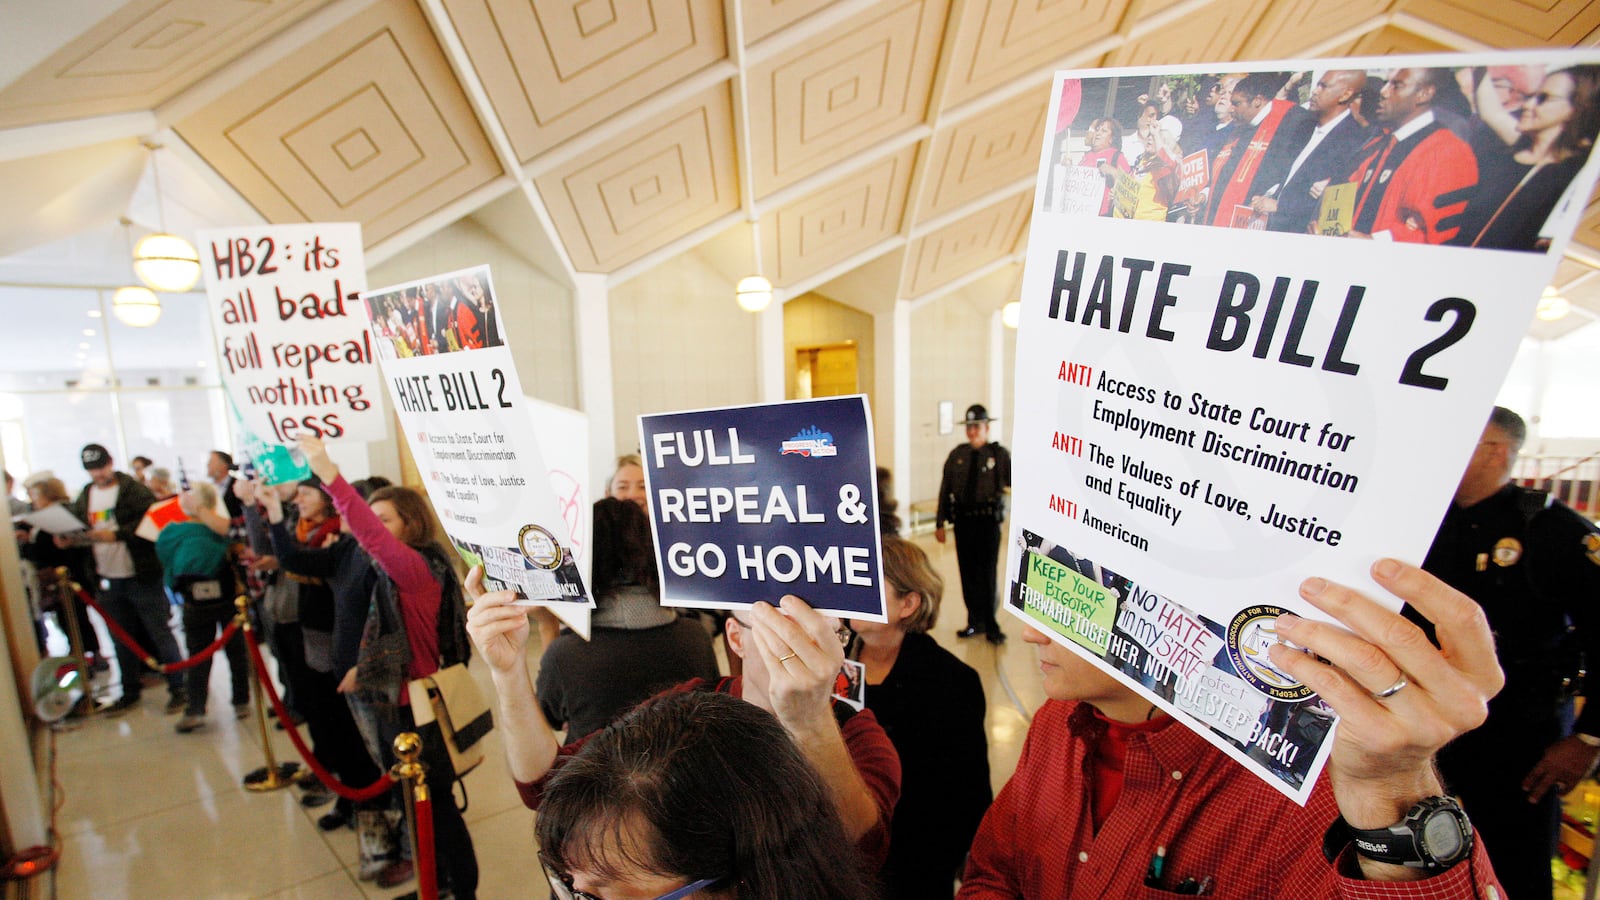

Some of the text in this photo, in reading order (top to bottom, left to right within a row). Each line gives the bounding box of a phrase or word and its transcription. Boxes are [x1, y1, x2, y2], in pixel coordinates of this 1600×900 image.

[304, 236, 340, 272] its
[221, 287, 258, 325] all
[1048, 249, 1477, 392] HATE BILL 2
[223, 329, 373, 380] full repeal
[247, 375, 372, 412] nothing
[394, 367, 513, 413] HATE BILL 2
[1057, 360, 1356, 453] ANTI Access to State Court for
[267, 411, 345, 443] less
[473, 432, 493, 444] Court
[493, 431, 505, 444] for
[652, 427, 756, 469] FULL
[1092, 399, 1359, 494] Employment Discrimination
[499, 474, 526, 487] Justice
[1051, 430, 1343, 547] ANTI The Values of Love, Justice
[1085, 474, 1182, 527] and Equality
[658, 483, 868, 525] REPEAL &
[1049, 493, 1149, 552] ANTI American
[667, 541, 873, 587] GO HOME
[1033, 555, 1106, 609] KEEP YOUR
[1045, 581, 1097, 619] BIGOTRY
[1132, 584, 1213, 657] NO HATE
[1156, 634, 1206, 681] STATE
[1228, 606, 1281, 684] NATIONAL ASSOCIATION FOR THE
[1019, 582, 1072, 627] FORWARD
[1075, 613, 1140, 669] TOGETHER.
[1143, 653, 1173, 687] NOT
[1249, 719, 1299, 768] BACK!
[1200, 673, 1249, 701] rotect
[1269, 686, 1299, 698] PEOPLE
